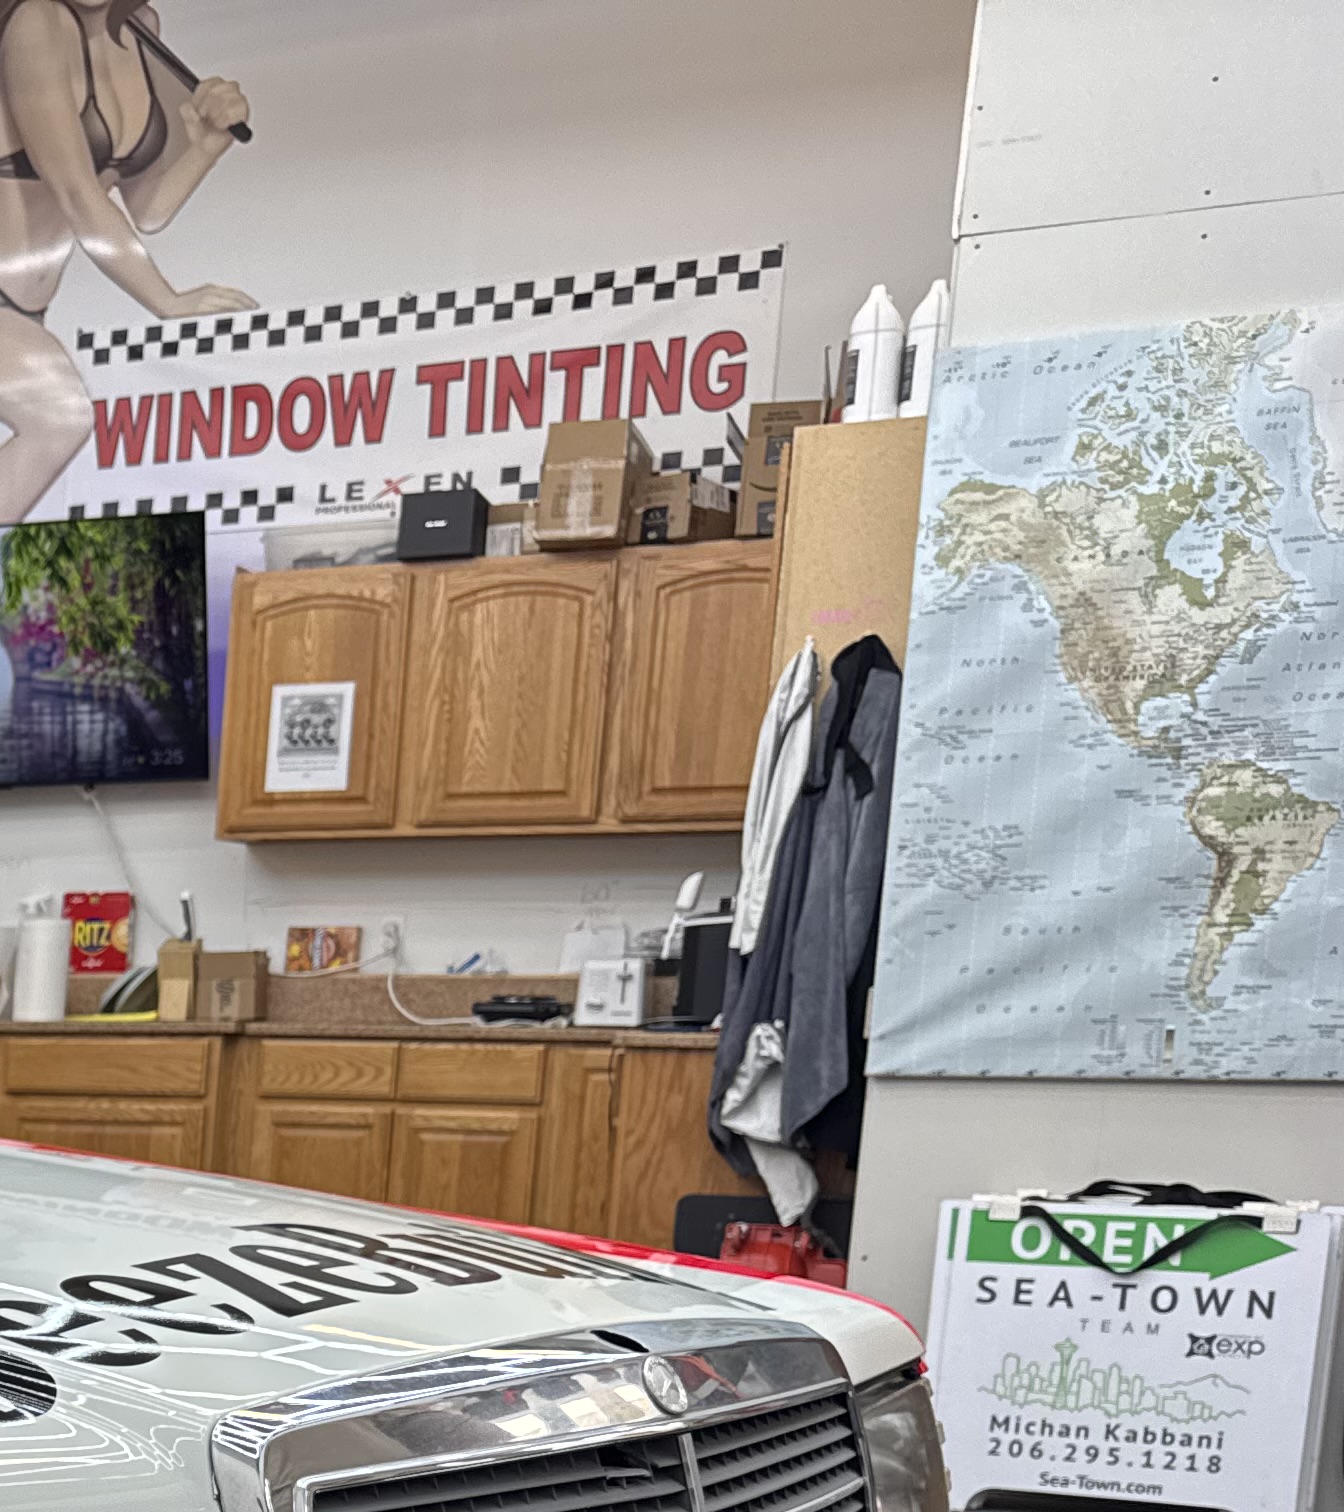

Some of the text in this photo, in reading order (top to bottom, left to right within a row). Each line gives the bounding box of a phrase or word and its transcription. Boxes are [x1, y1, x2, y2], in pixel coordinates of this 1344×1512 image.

[93, 368, 396, 469] WINDOW
[416, 330, 748, 438] TINTING
[74, 920, 111, 947] RITZ
[1010, 1217, 1186, 1267] OPEN
[975, 1276, 1277, 1320] SEA-TOWN
[1079, 1318, 1161, 1336] TEAM
[1216, 1337, 1266, 1360] exp
[988, 1414, 1226, 1451] Michan Kabbani
[987, 1437, 1223, 1475] 206.295.1218
[1038, 1471, 1164, 1496] Sea-Town.com
